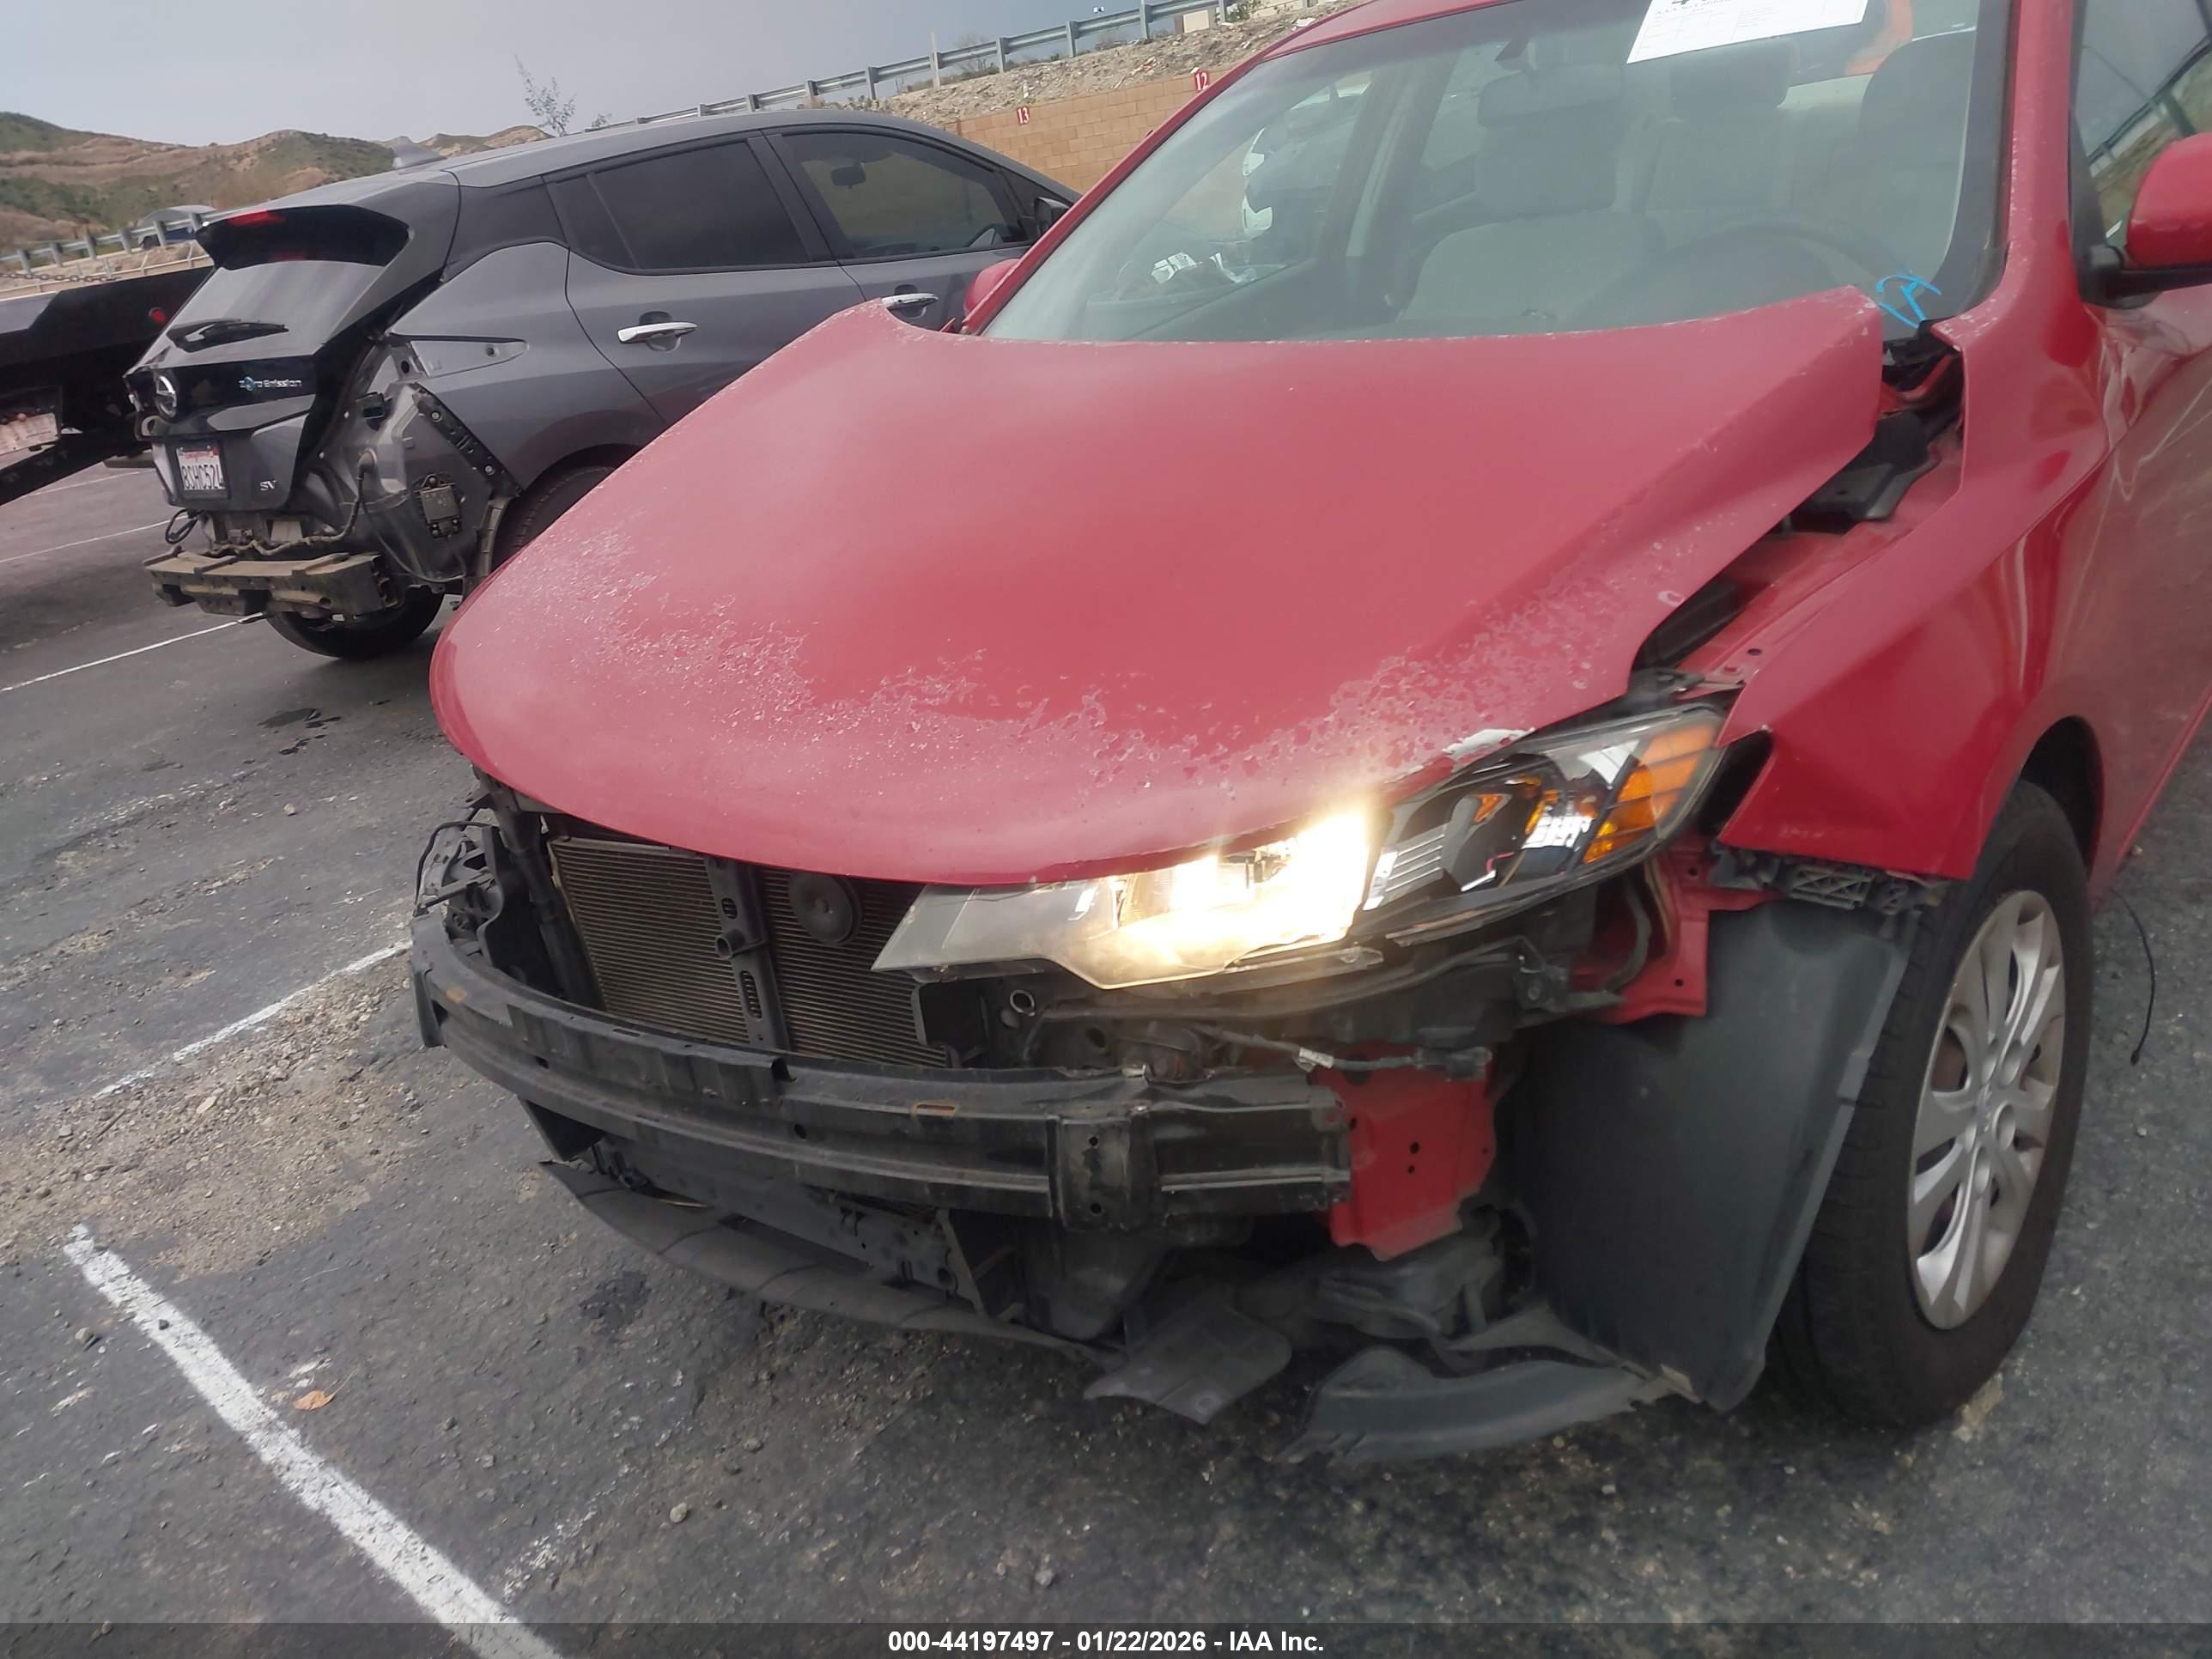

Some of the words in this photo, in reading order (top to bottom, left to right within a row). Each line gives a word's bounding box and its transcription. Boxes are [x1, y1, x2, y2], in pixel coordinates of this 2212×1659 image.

[1194, 70, 1208, 91] 12
[1017, 106, 1030, 124] 13
[259, 479, 277, 491] SV
